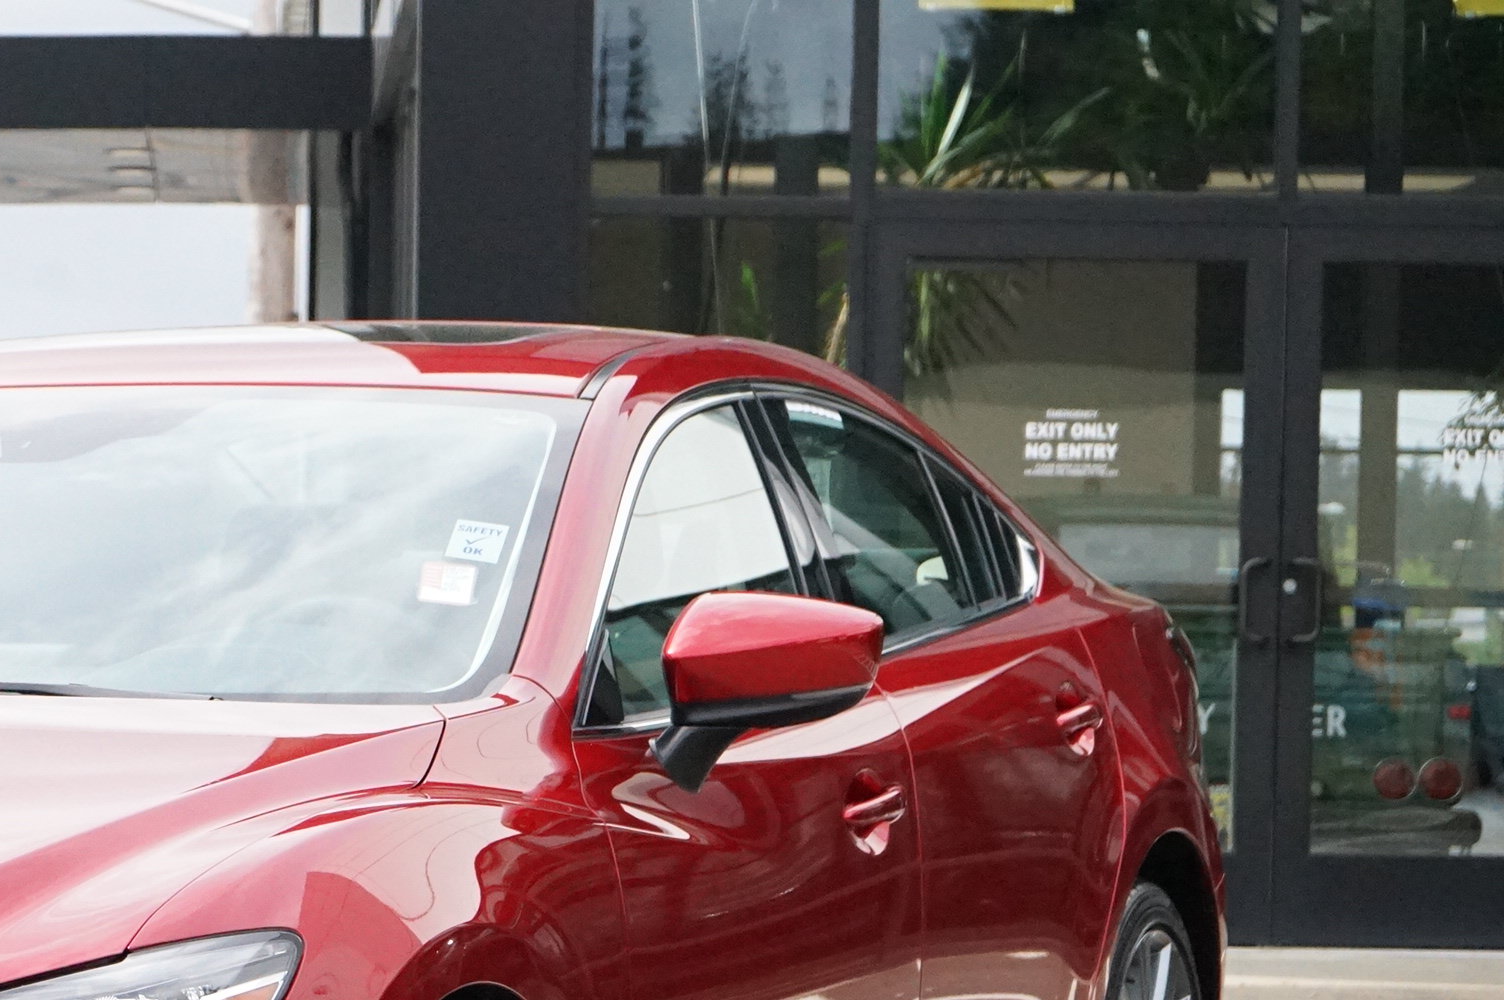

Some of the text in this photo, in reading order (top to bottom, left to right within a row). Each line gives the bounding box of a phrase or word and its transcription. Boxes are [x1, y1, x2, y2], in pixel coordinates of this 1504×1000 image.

[1025, 421, 1119, 441] EXIT ONLY
[1024, 441, 1119, 461] NO ENTRY
[457, 524, 503, 537] SAFETY
[462, 546, 484, 556] OK
